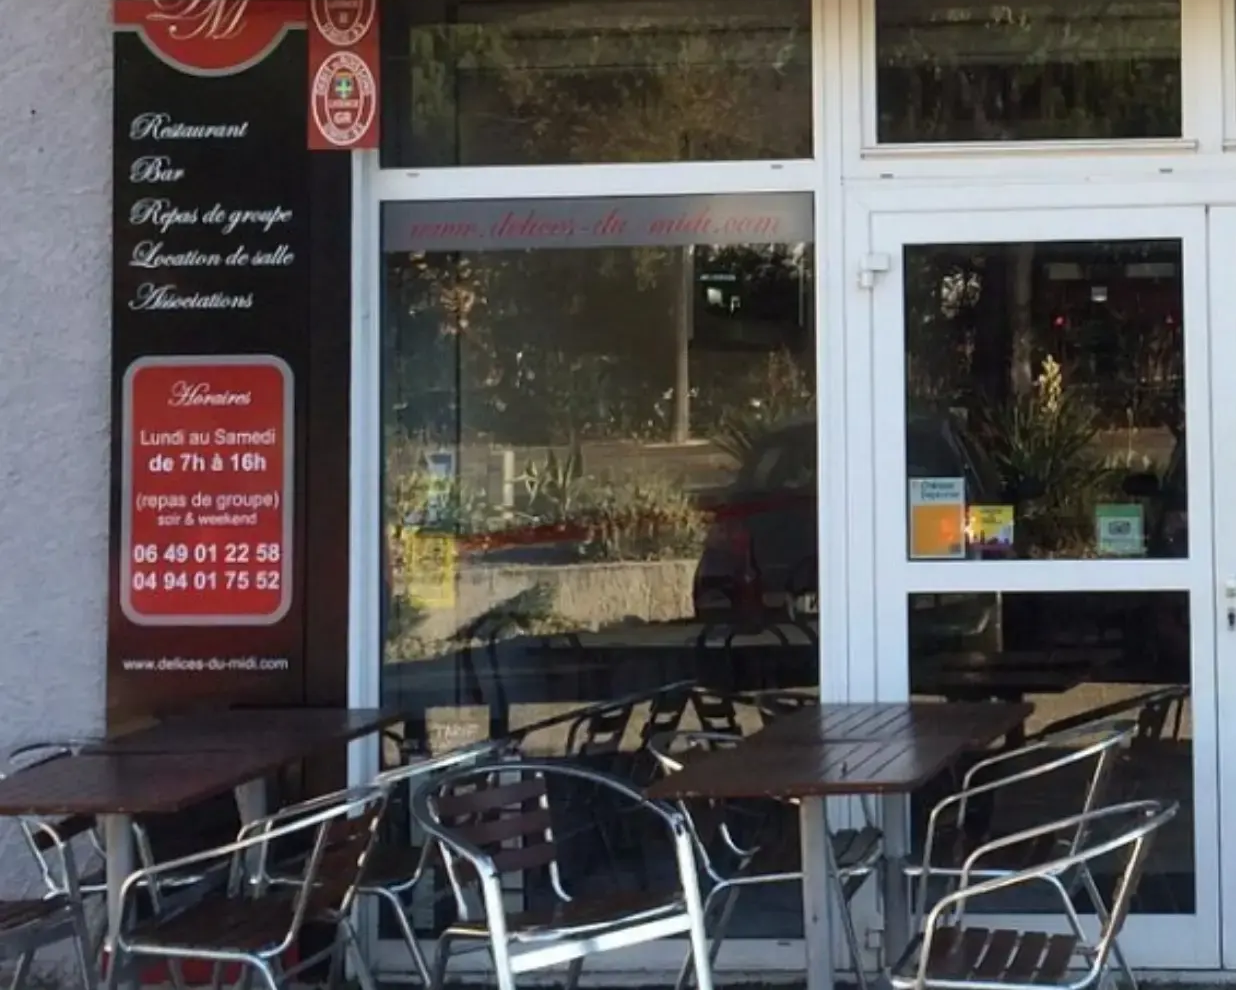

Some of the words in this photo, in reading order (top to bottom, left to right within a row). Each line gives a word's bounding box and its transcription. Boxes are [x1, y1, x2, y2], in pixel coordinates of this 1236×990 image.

[129, 112, 250, 142] Restaurant
[129, 155, 185, 184] Bar
[128, 197, 199, 234] Repas
[202, 203, 226, 224] de
[223, 205, 294, 236] groupe
[128, 240, 220, 269] Location
[225, 245, 249, 267] de
[251, 244, 295, 267] salle
[127, 283, 253, 310] Associations
[168, 380, 252, 407] Horaires
[140, 429, 184, 446] Lundi
[189, 432, 211, 446] au
[214, 428, 276, 446] Samedi
[149, 454, 174, 472] de
[180, 454, 206, 472] 7h
[210, 453, 223, 472] à
[230, 453, 267, 472] 16h
[136, 491, 186, 511] (repas
[191, 492, 212, 509] de
[216, 491, 280, 511] groupe)
[157, 512, 183, 526] soir
[198, 512, 258, 526] weekend
[134, 544, 158, 562] 06
[163, 544, 188, 562] 49
[194, 544, 218, 562] 01
[225, 544, 250, 562] 22
[256, 544, 281, 562] 58
[132, 571, 157, 590] 04
[163, 571, 188, 590] 94
[194, 571, 218, 590] 01
[225, 571, 250, 590] 75
[256, 571, 280, 590] 52
[124, 656, 289, 673] www.delices-du-midi.com
